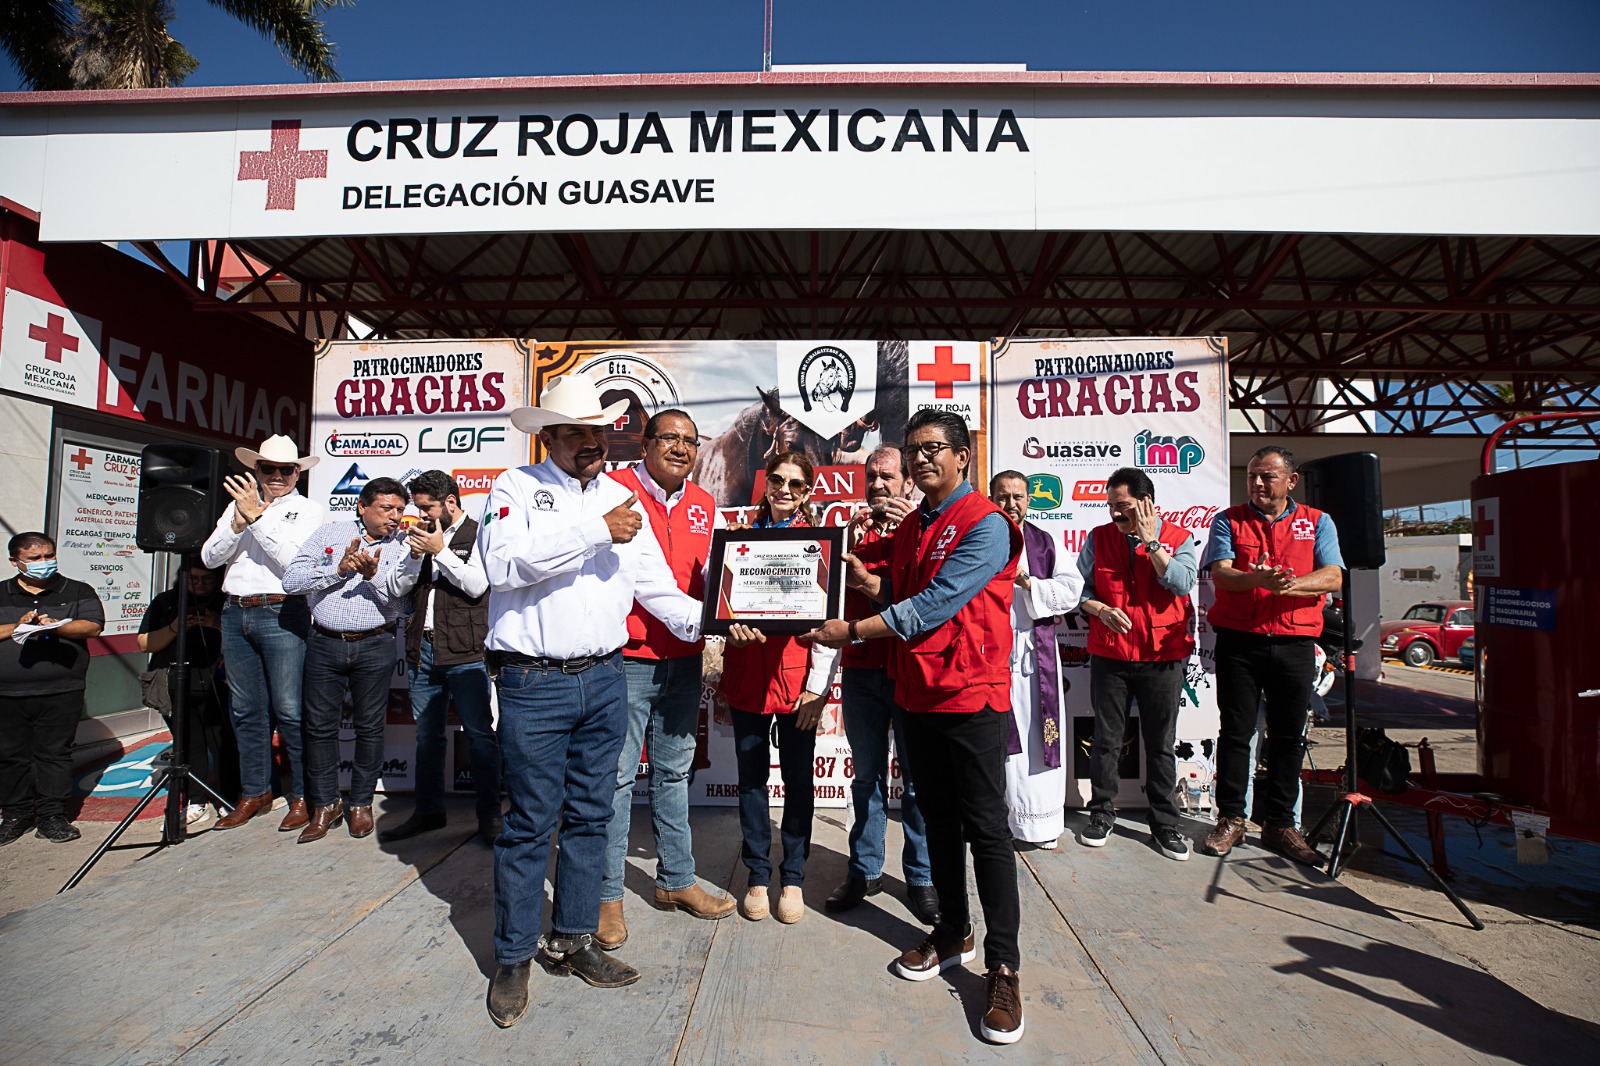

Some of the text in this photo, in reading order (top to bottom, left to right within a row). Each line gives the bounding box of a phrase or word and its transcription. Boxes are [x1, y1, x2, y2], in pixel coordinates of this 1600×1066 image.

[346, 108, 1030, 162] CRUZ ROJA MEXICANA
[342, 176, 715, 210] DELEGACIÓN GUASAVE
[353, 352, 483, 378] PATROCINADORES
[608, 360, 631, 375] 6ta.
[1035, 350, 1175, 378] PATROCINADORES
[25, 363, 77, 382] CRUZ ROJA
[24, 372, 76, 391] MEXICANA
[334, 371, 506, 419] GRACIAS
[1016, 371, 1201, 420] GRACIAS
[945, 403, 971, 412] ROJA
[333, 437, 403, 450] CAMAJOAL
[1134, 429, 1205, 475] imp
[105, 453, 141, 466] FARMAC
[103, 461, 128, 474] CRUZ
[86, 492, 135, 504] MEDICAMENTO
[77, 507, 113, 517] GENÉRICO,
[74, 516, 104, 524] MATERIAL
[65, 529, 103, 538] RECARGAS
[103, 531, 131, 539] (TIEMPO
[740, 567, 811, 576] RECONOCIMIENTO
[124, 591, 141, 600] CFE
[1496, 587, 1521, 596] ACEROS
[1496, 598, 1551, 609] AGRONEGOCIOS
[1496, 607, 1537, 617] MAQUINARIA
[1496, 616, 1538, 628] FERRETERÍA
